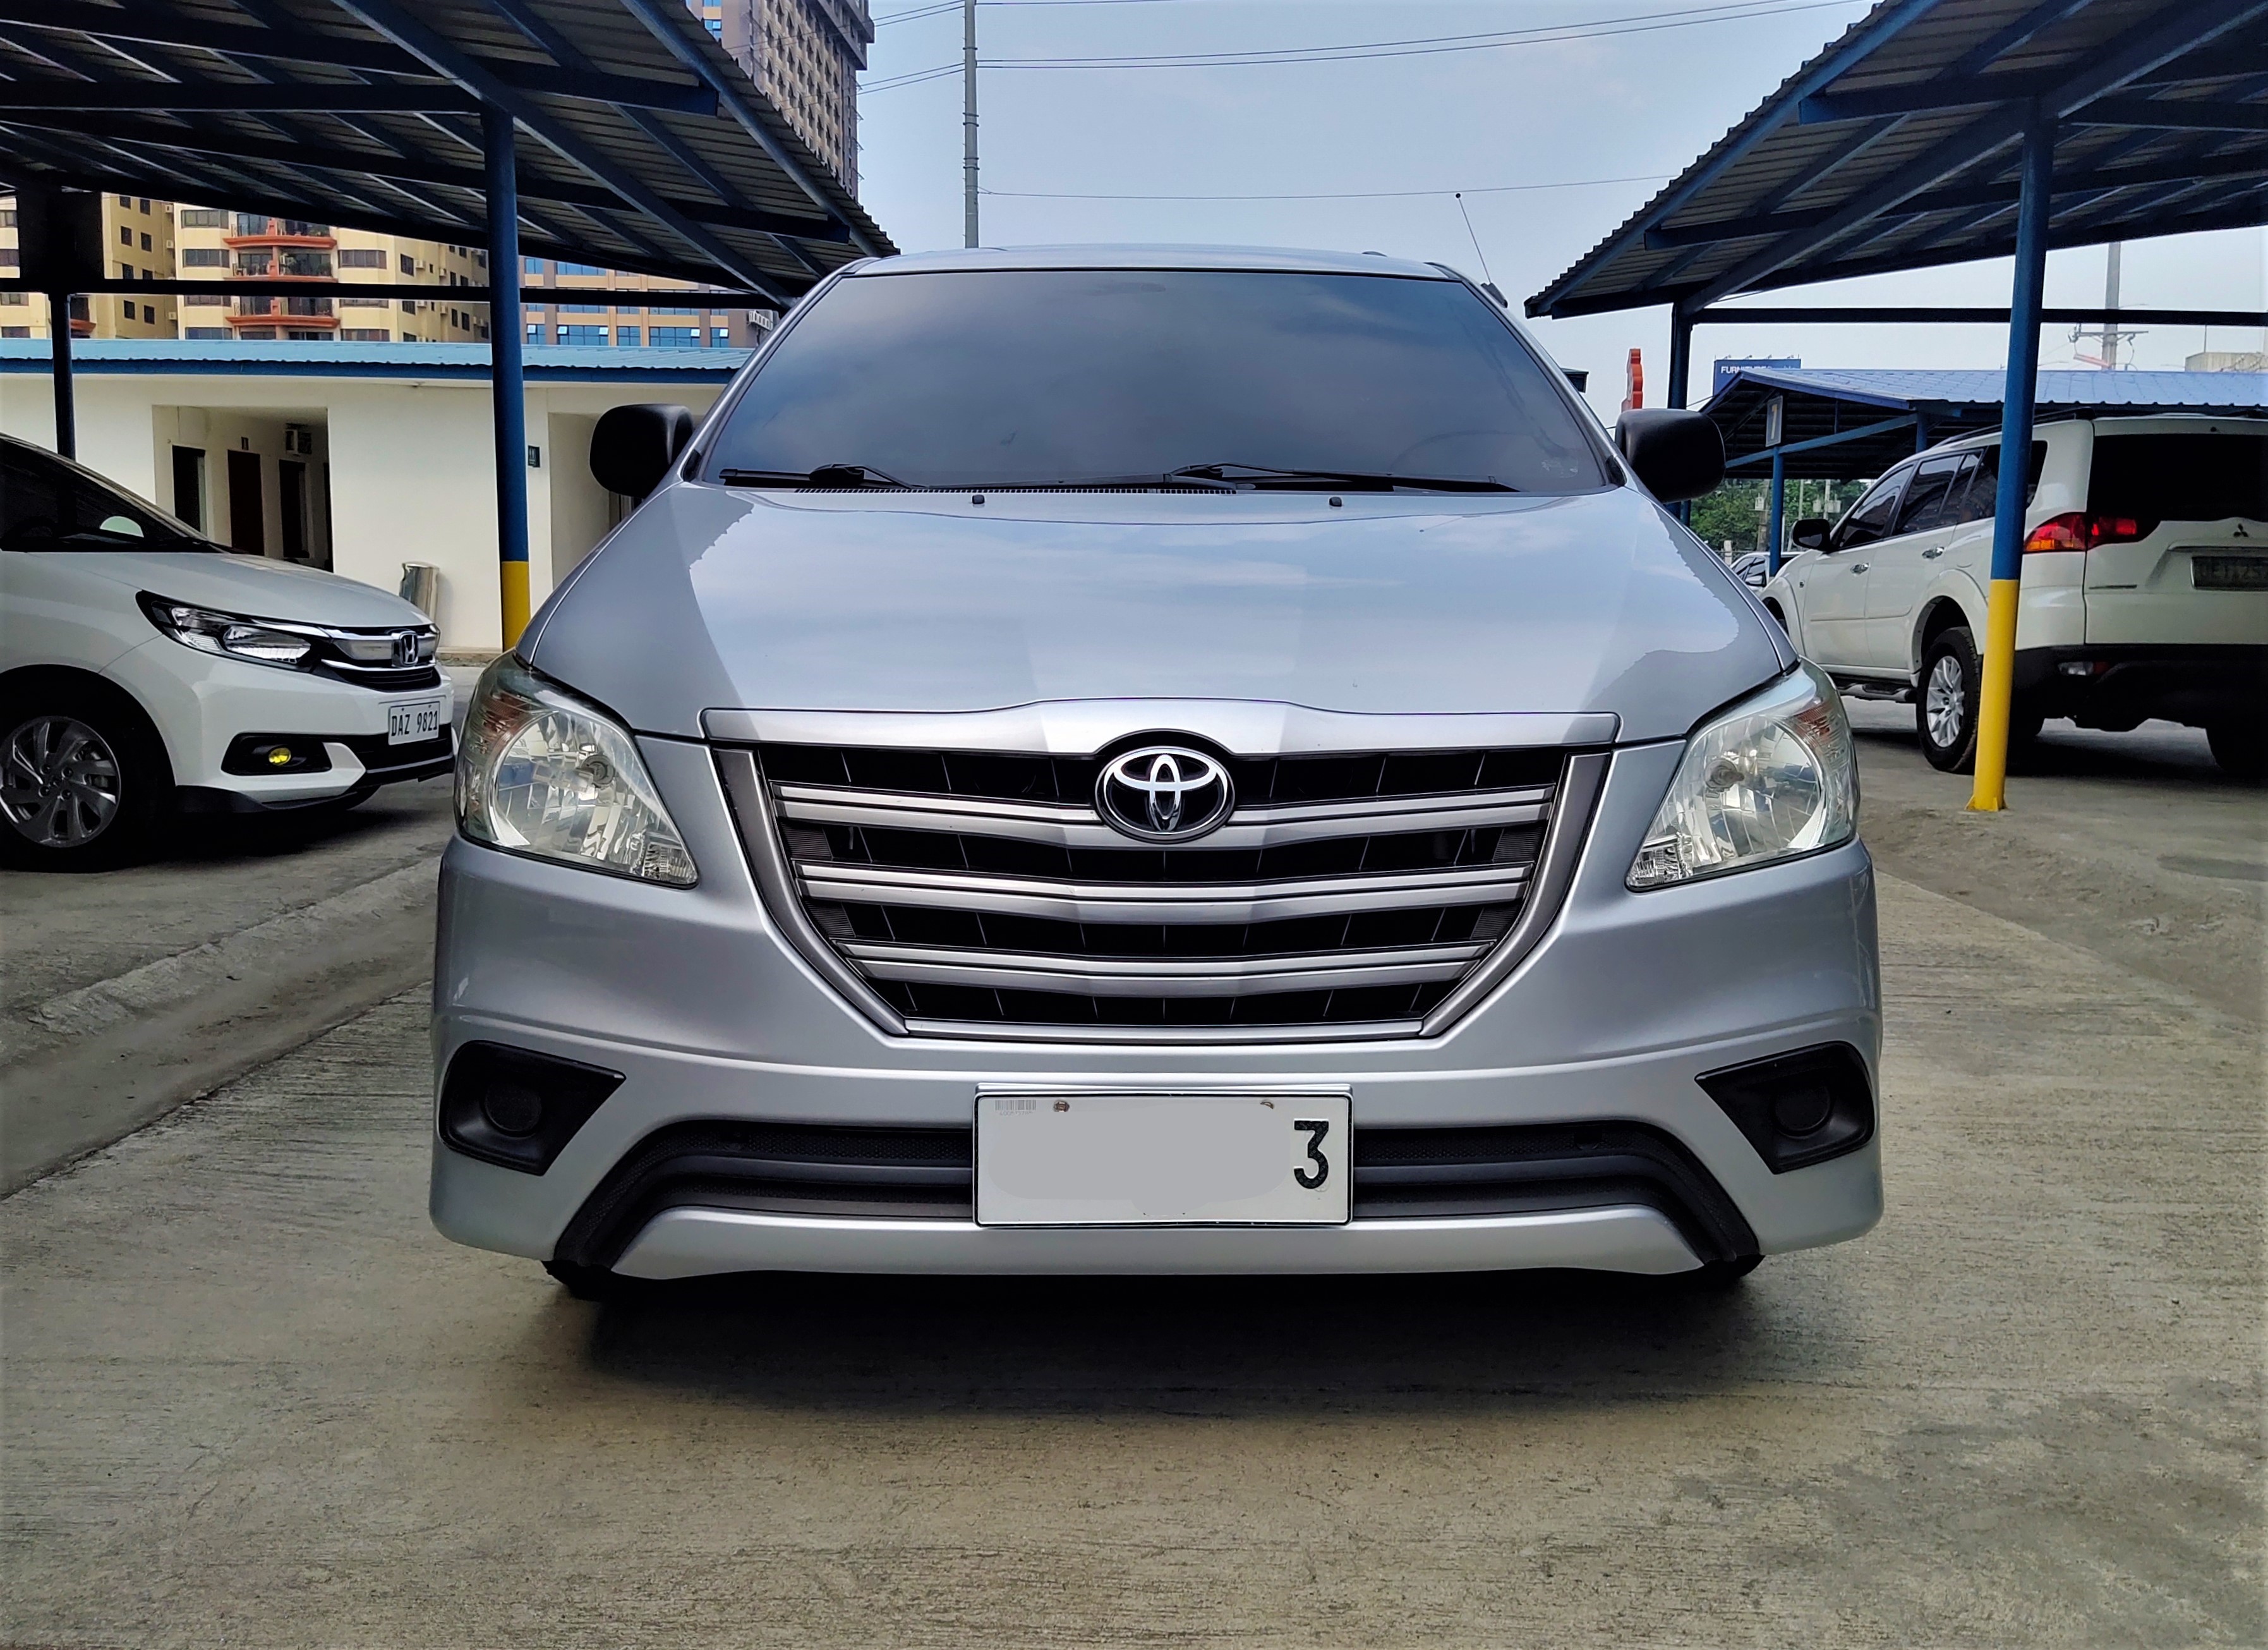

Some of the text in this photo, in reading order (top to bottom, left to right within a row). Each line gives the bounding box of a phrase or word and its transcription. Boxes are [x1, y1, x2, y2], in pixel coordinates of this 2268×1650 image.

[391, 710, 437, 736] DAZ 9821
[1293, 1120, 1329, 1189] 3
